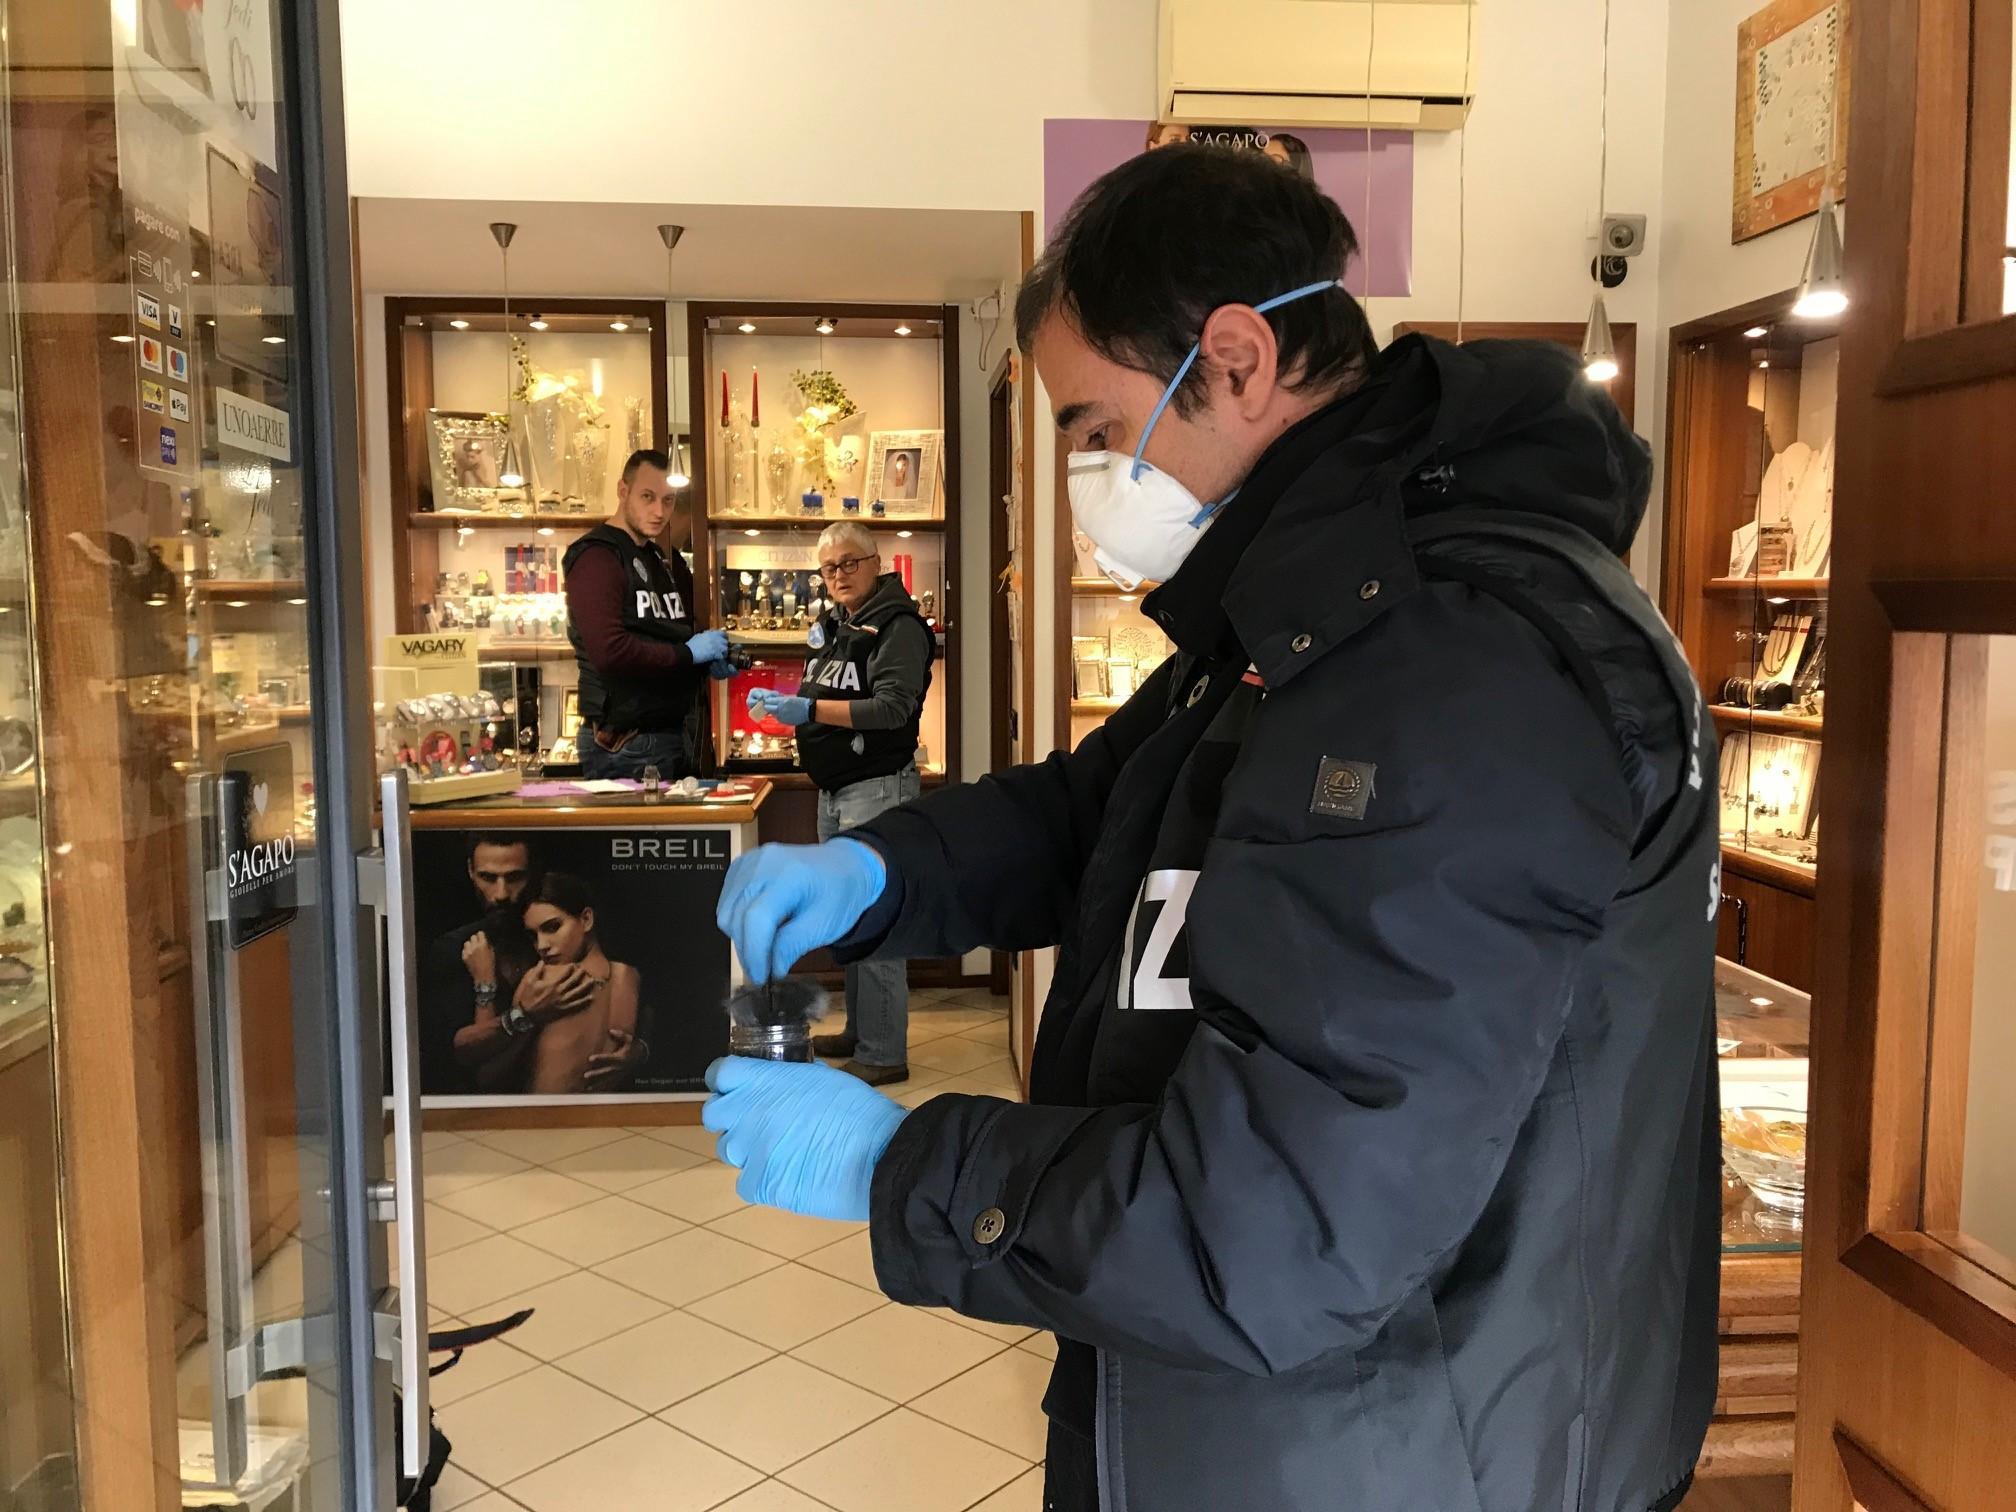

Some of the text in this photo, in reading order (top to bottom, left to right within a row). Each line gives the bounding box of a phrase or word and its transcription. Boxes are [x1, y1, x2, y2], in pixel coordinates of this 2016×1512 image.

[141, 301, 158, 320] VISA
[222, 402, 286, 449] UNOAERRE
[401, 638, 466, 654] VAGARY
[611, 838, 725, 858] BREIL
[611, 863, 724, 871] DON'T TOUCH MY BREIL
[262, 874, 273, 885] PER
